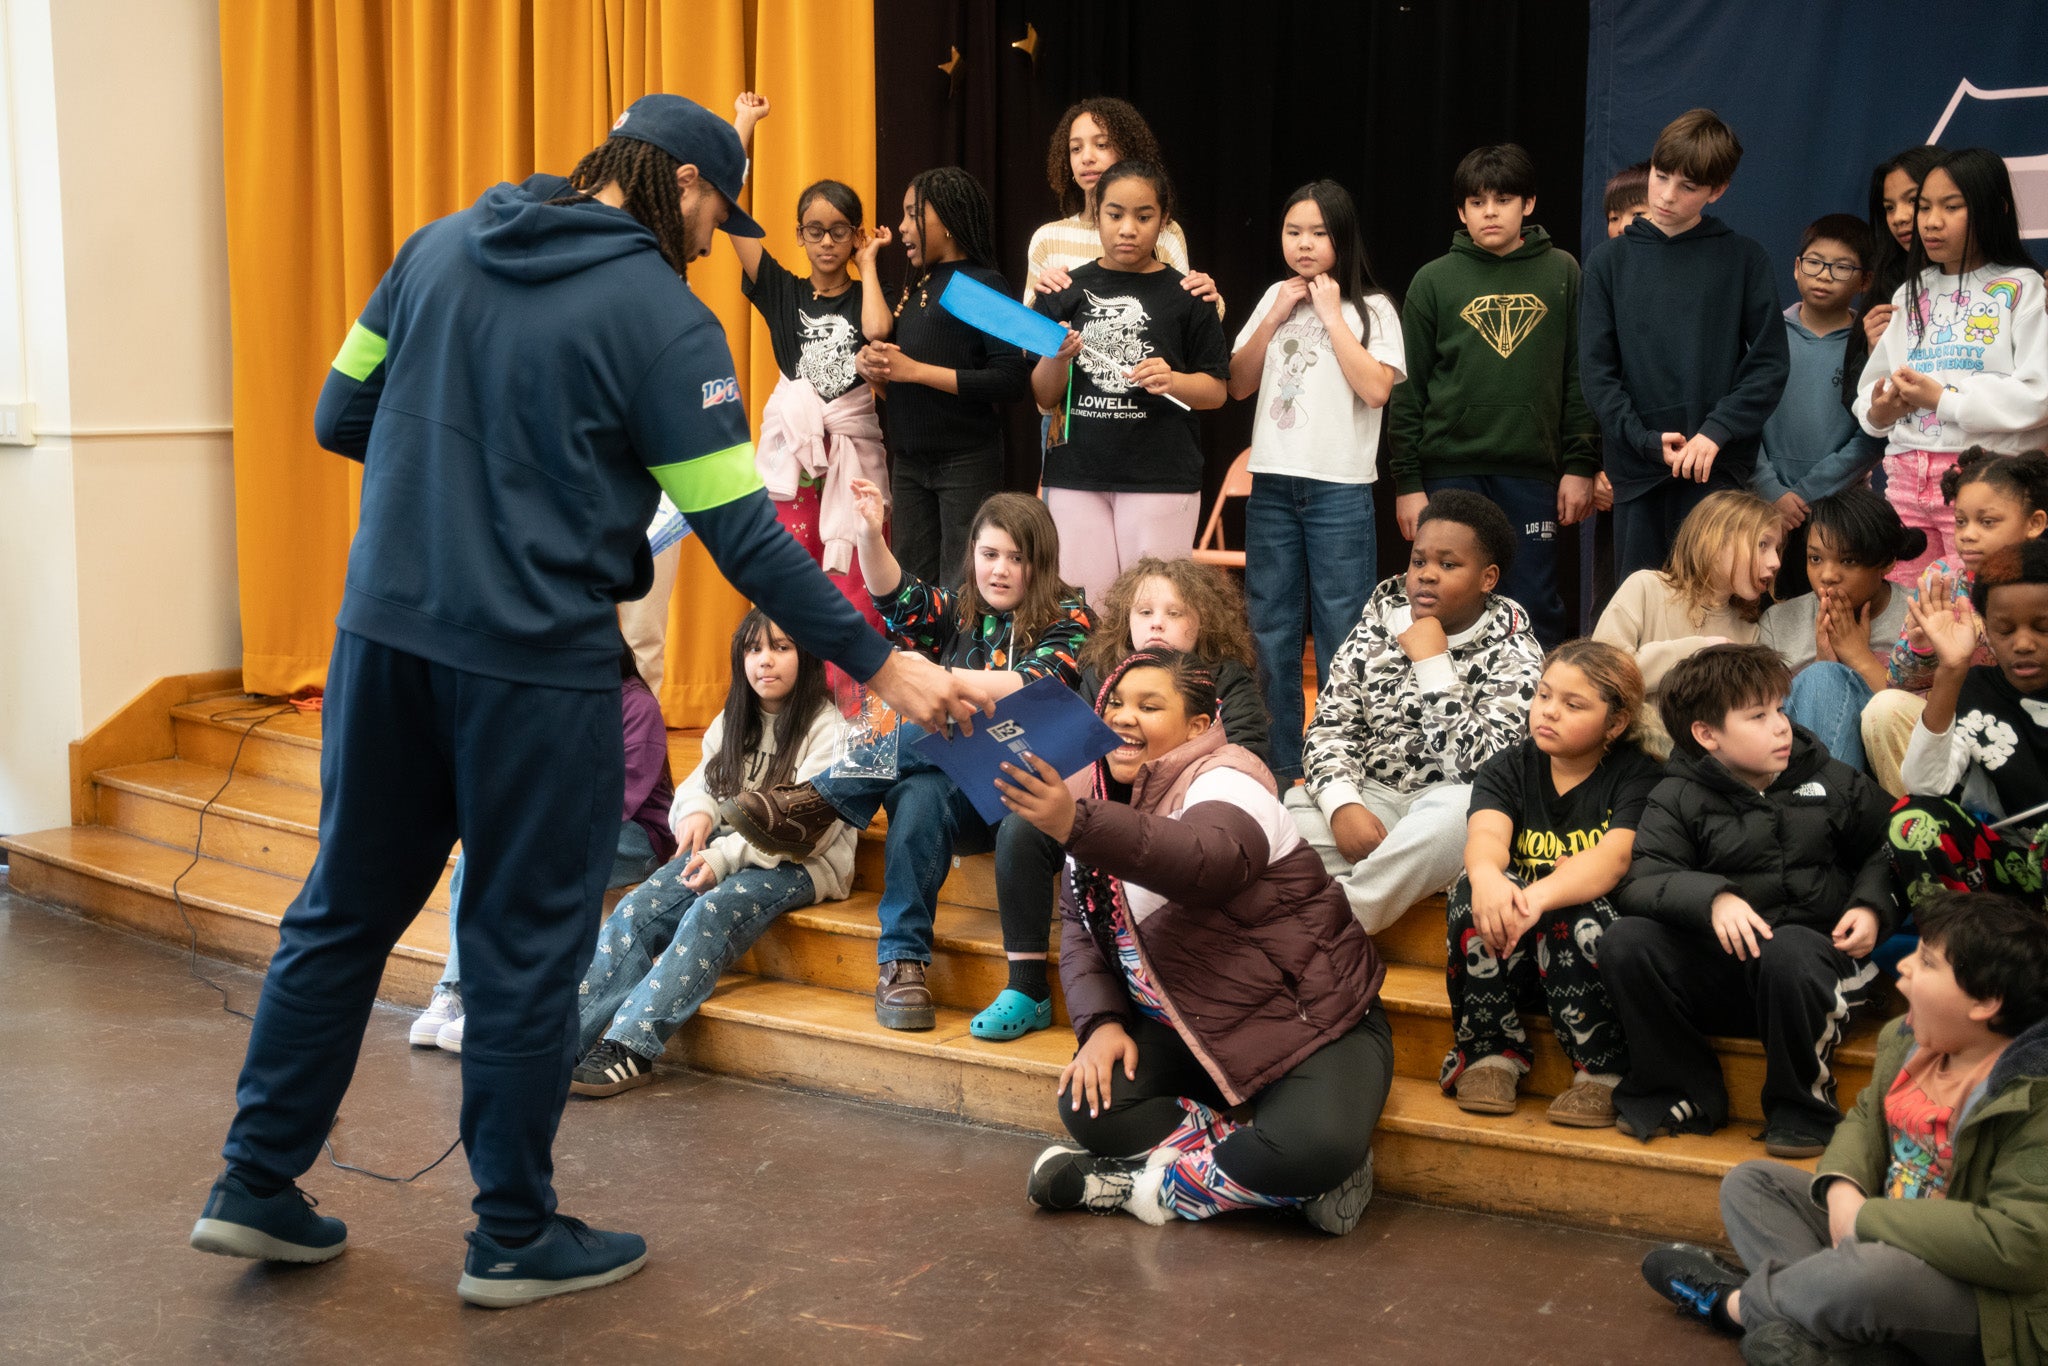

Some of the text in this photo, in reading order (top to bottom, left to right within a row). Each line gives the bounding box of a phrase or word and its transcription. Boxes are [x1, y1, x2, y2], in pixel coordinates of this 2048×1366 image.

[1908, 344, 1985, 361] HELLO KITTY
[1908, 360, 1935, 373] AND
[1078, 394, 1138, 410] LOWELL
[1070, 408, 1147, 419] ELEMENTARY SCHOOL
[1525, 522, 1540, 535] LOS
